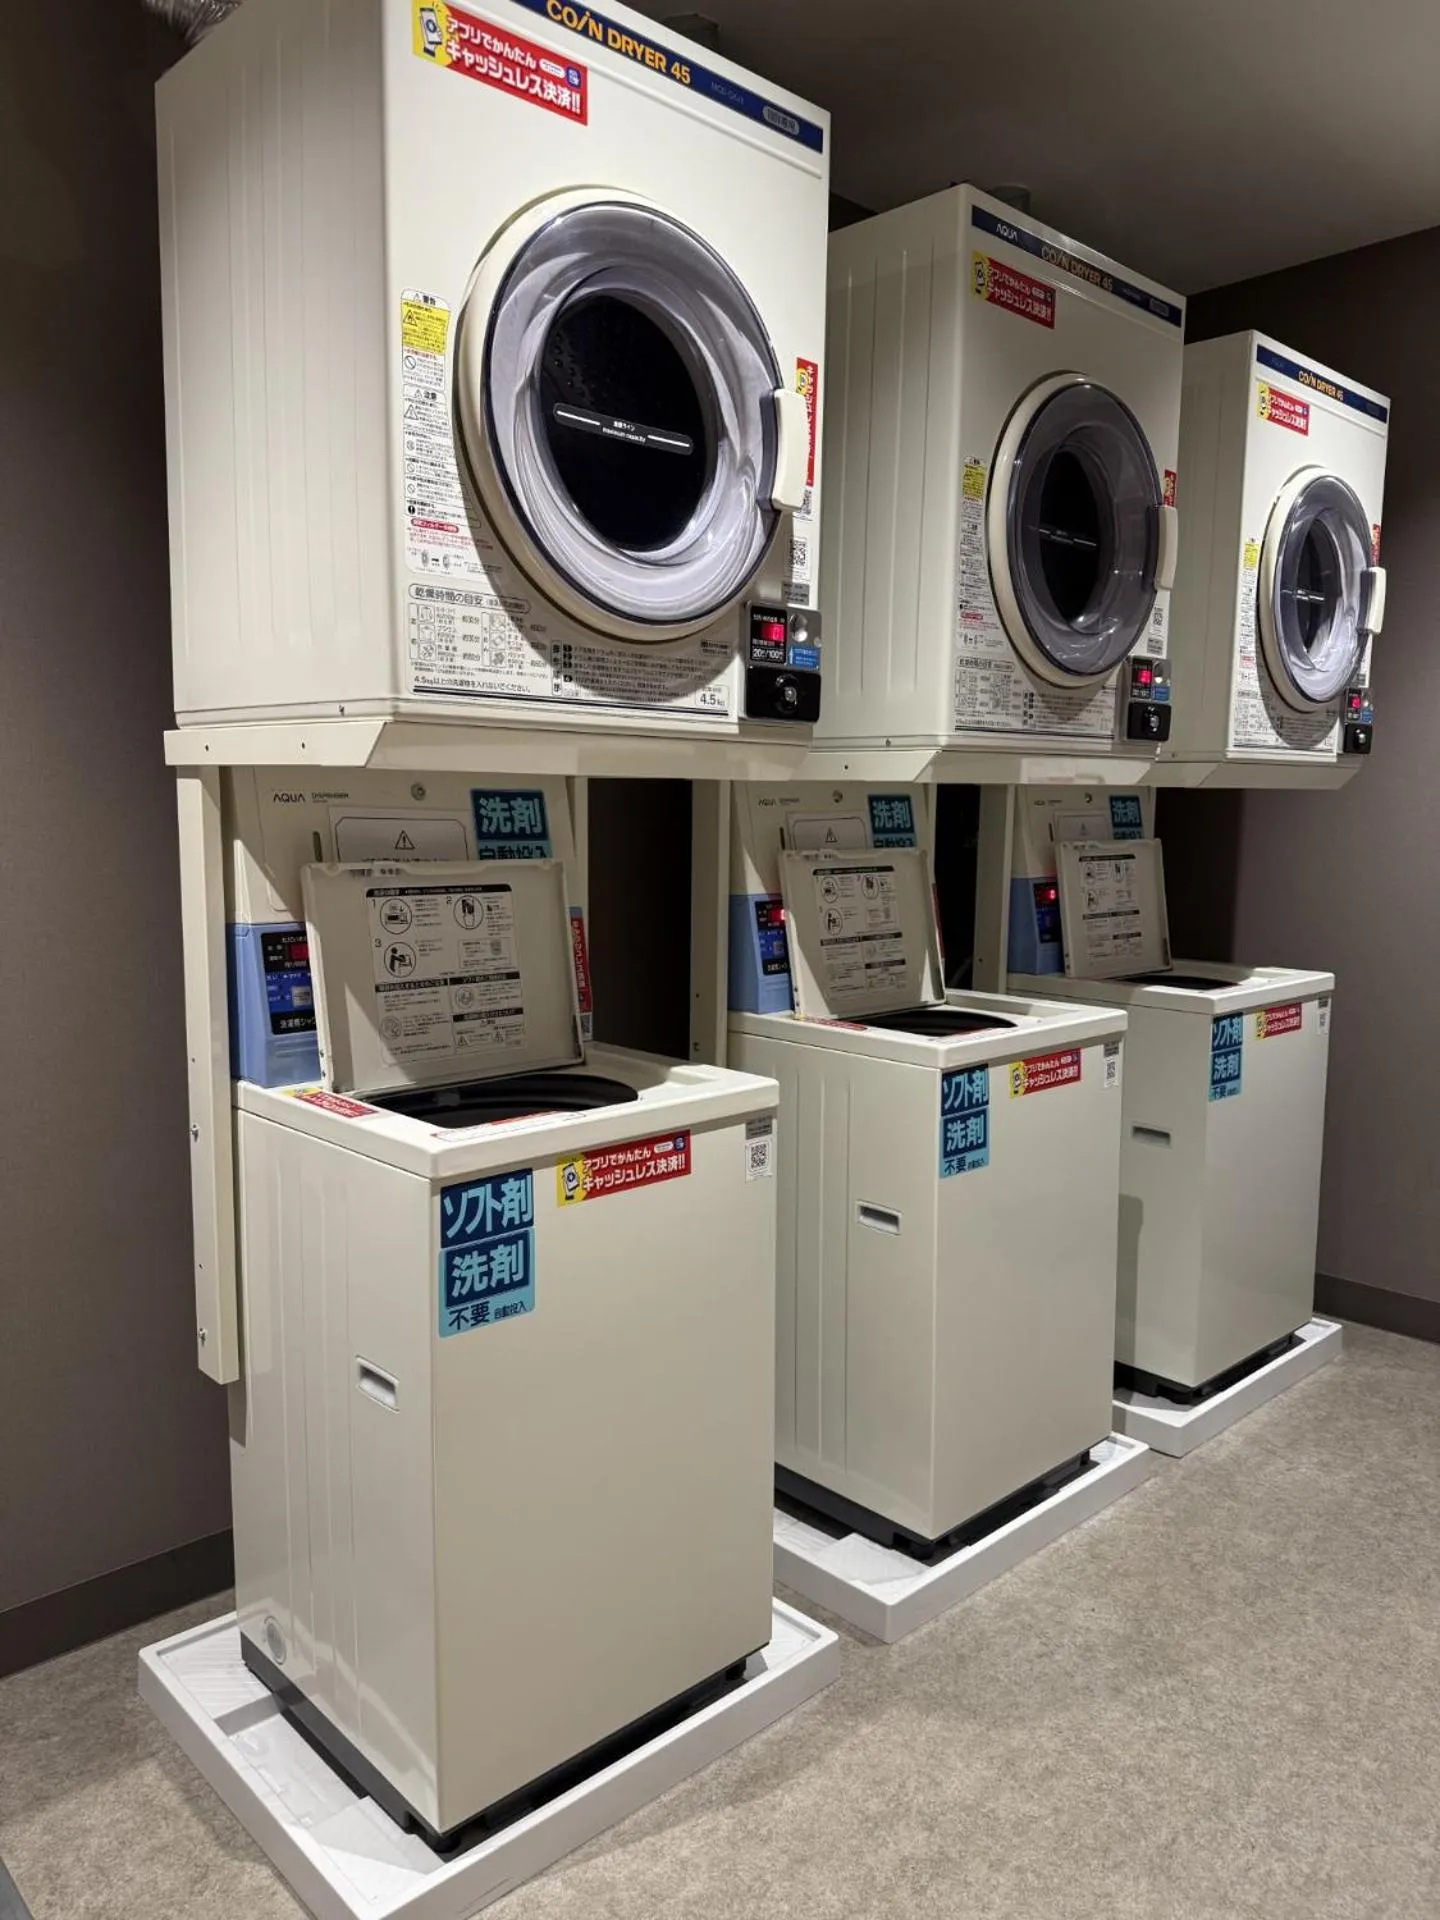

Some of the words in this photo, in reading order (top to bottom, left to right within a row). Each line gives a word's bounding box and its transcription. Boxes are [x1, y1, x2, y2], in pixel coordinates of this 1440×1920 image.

[446, 17, 536, 70] アプリでかんたん
[608, 26, 667, 73] DRYER
[671, 61, 691, 85] 45
[446, 40, 581, 114] キャッシュレス決済!!
[996, 223, 1018, 241] AQUA
[273, 792, 305, 803] AQUA
[480, 796, 542, 834] 洗剤
[872, 800, 911, 828] 洗剤
[942, 1070, 989, 1109] ソフト剤
[946, 1115, 984, 1151] 洗剤
[582, 1154, 686, 1192] キャッシュレス決済!!
[583, 1146, 652, 1172] アプリでかんたん
[944, 1156, 968, 1176] 不要
[443, 1174, 533, 1238] ソフト剤
[451, 1240, 525, 1298] 洗剤
[449, 1301, 490, 1331] 不要
